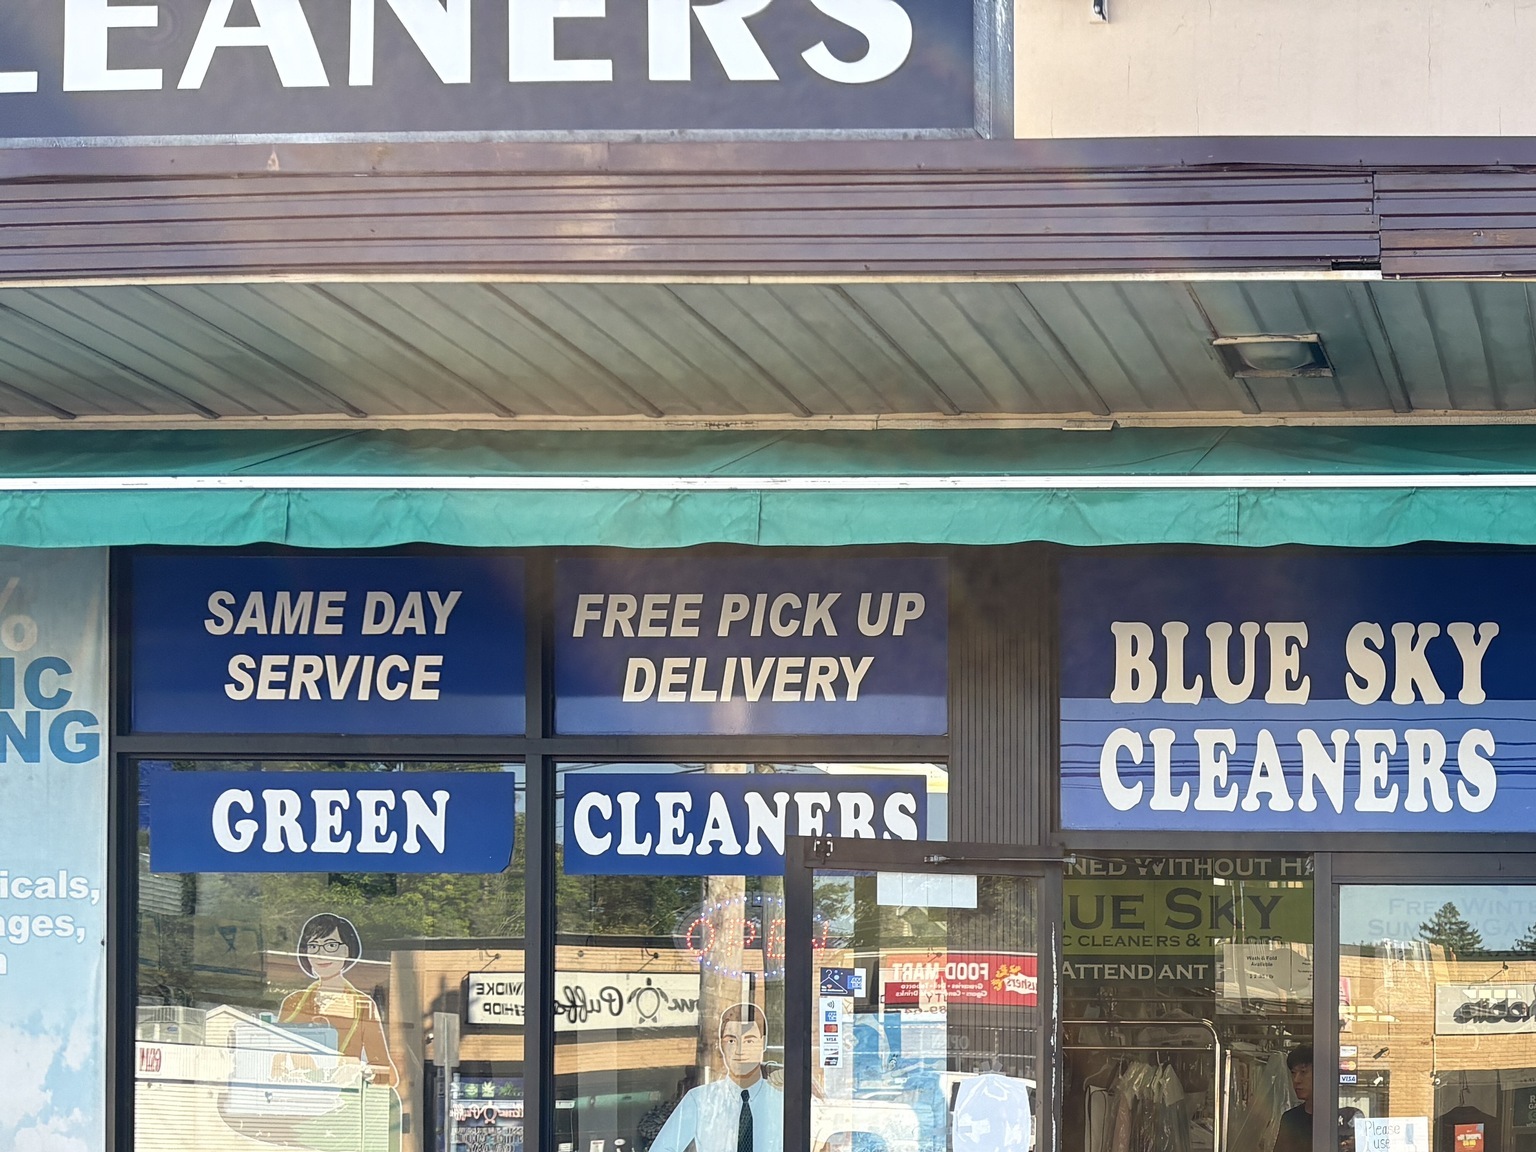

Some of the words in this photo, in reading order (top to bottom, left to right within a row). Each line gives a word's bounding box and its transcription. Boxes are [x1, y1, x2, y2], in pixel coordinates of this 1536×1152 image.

[0, 0, 913, 93] EANERS
[204, 591, 347, 635] SAME
[361, 591, 462, 635] DAY
[572, 593, 703, 637] FREE
[717, 592, 841, 637] PICK
[857, 592, 925, 636] UP
[224, 654, 444, 700] SERVICE
[622, 656, 874, 702] DELIVERY
[1110, 621, 1310, 705] BLUE
[1345, 621, 1500, 705] SKY
[1100, 727, 1497, 814] CLEANERS
[212, 788, 450, 854] GREEN
[573, 791, 918, 856] CLEANERS
[1063, 893, 1146, 931] UE
[1389, 898, 1440, 915] FRE
[1078, 935, 1180, 947] CLEANERS
[1186, 933, 1200, 947] &
[1206, 935, 1283, 947] TLORS
[1341, 1075, 1357, 1083] VISA
[1365, 1120, 1400, 1136] Please
[1373, 1138, 1390, 1150] use
